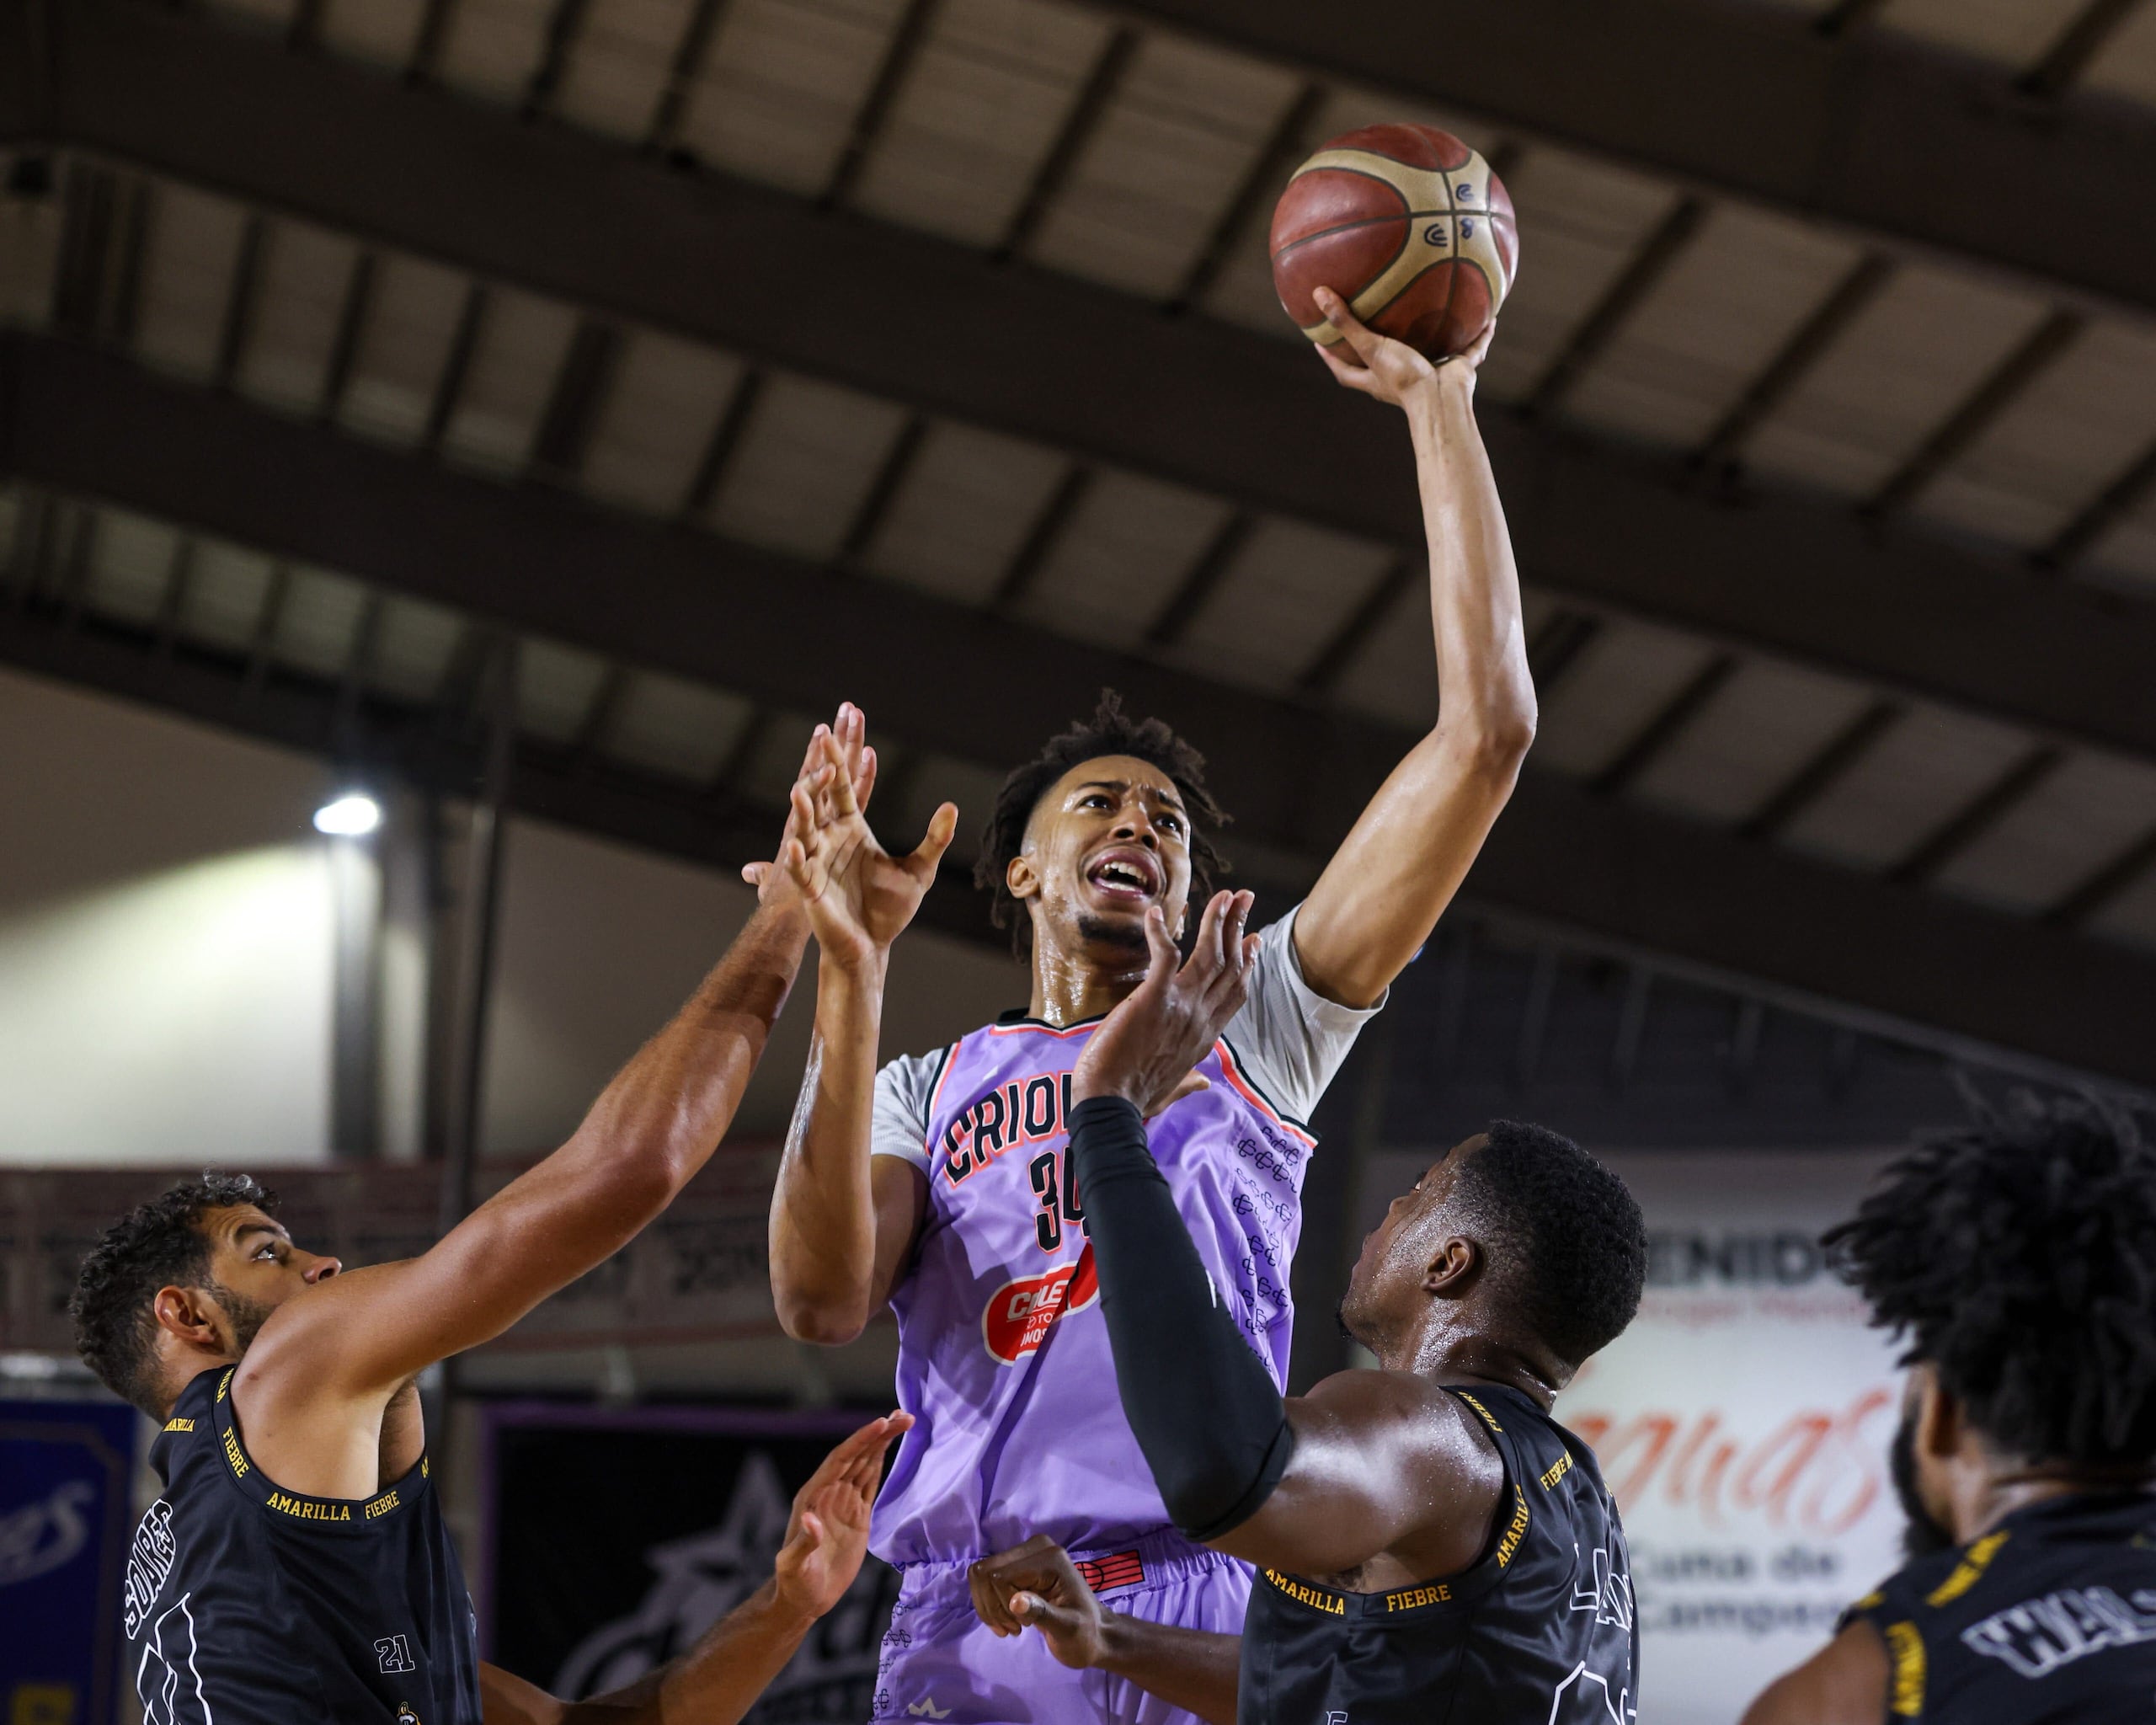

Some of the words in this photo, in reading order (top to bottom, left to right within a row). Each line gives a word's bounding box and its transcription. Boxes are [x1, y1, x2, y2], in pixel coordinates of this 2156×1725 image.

[222, 1426, 249, 1478] FIEBRE
[266, 1492, 351, 1521] AMARILLA
[365, 1490, 400, 1519] FIEBRE
[125, 1498, 175, 1640] SOARES
[1265, 1568, 1345, 1616] AMARILLA
[1386, 1584, 1451, 1612] FIEBRE
[374, 1634, 415, 1674] 21
